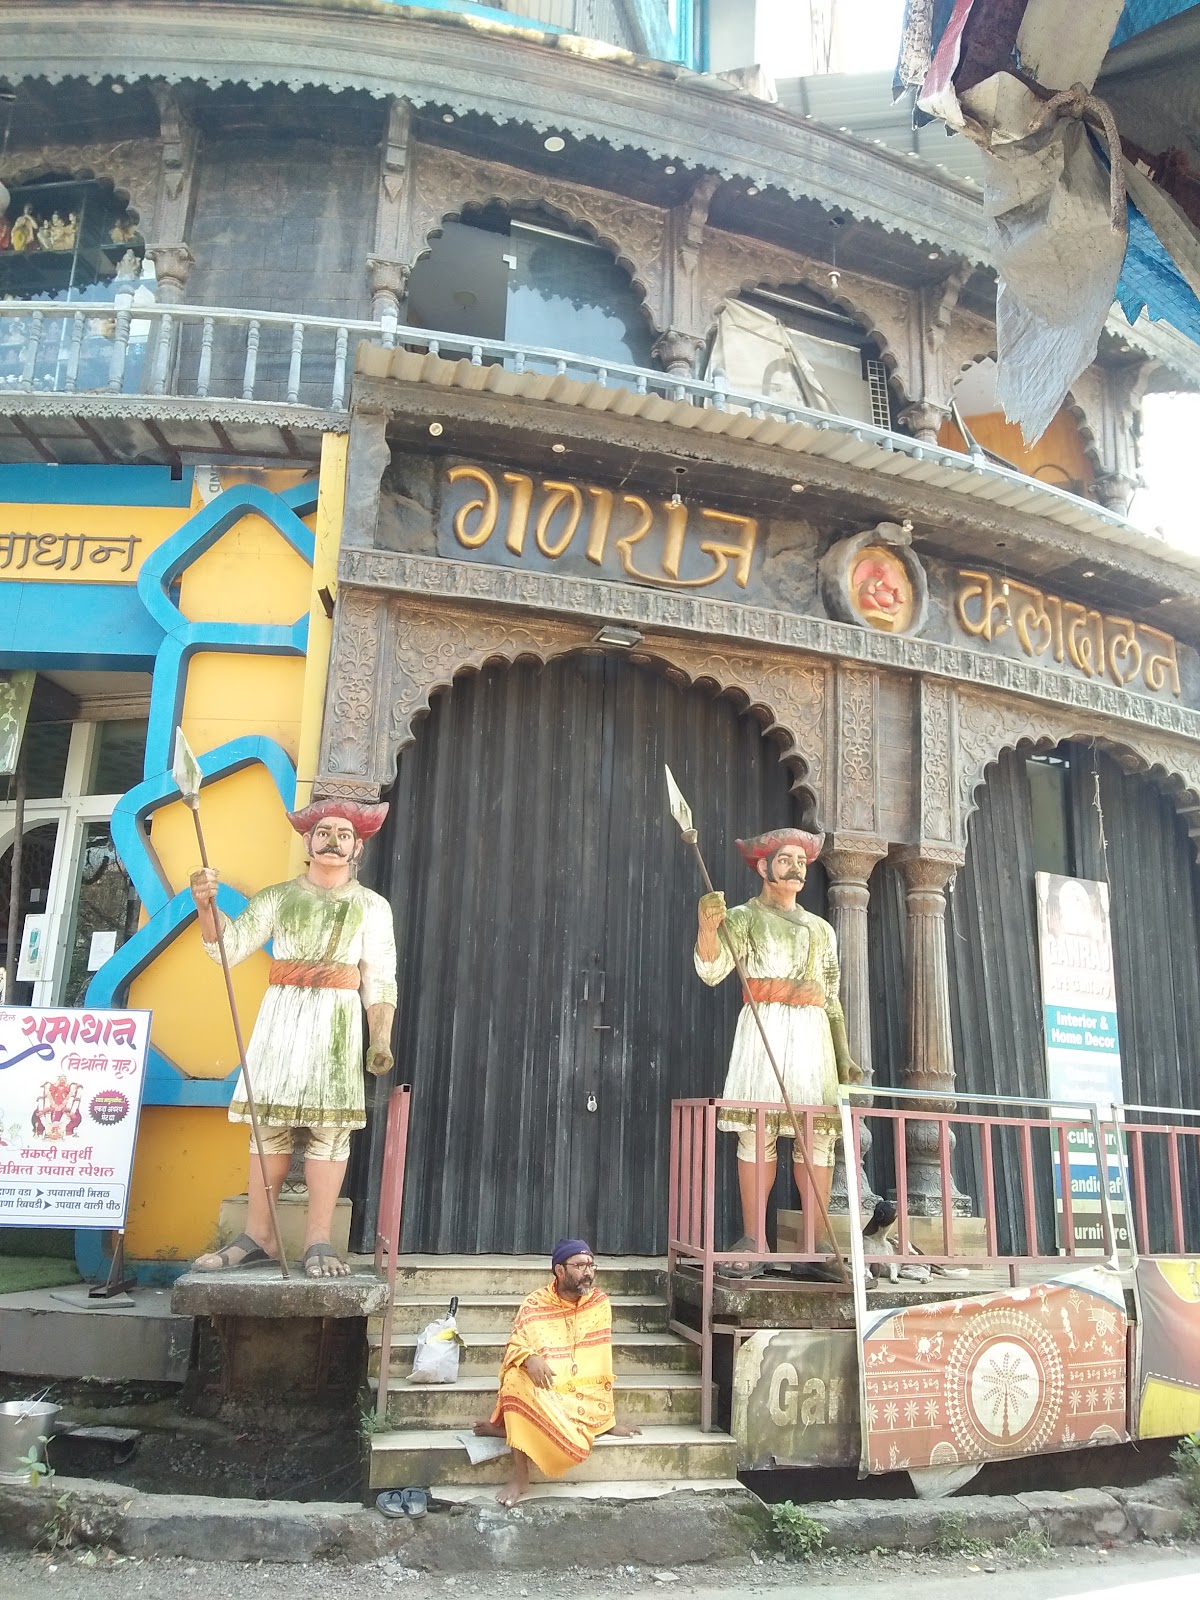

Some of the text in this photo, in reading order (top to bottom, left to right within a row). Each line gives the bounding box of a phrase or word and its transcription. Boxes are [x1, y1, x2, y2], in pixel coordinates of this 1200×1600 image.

[447, 465, 758, 589] गणराज
[955, 569, 1181, 698] कलादालन
[1056, 1010, 1109, 1030] Interior &
[22, 1014, 137, 1050] समाधान
[1051, 1027, 1116, 1049] Home Decor
[61, 1146, 93, 1163] चतुर्थी
[37, 1165, 75, 1176] उपवास
[79, 1163, 115, 1177] स्पेशल
[18, 1188, 32, 1197] वडा
[47, 1187, 110, 1198] उपवासाची मिसळ
[16, 1197, 42, 1209] खिचडी
[55, 1201, 81, 1210] उपवास
[106, 1200, 121, 1211] पीठ
